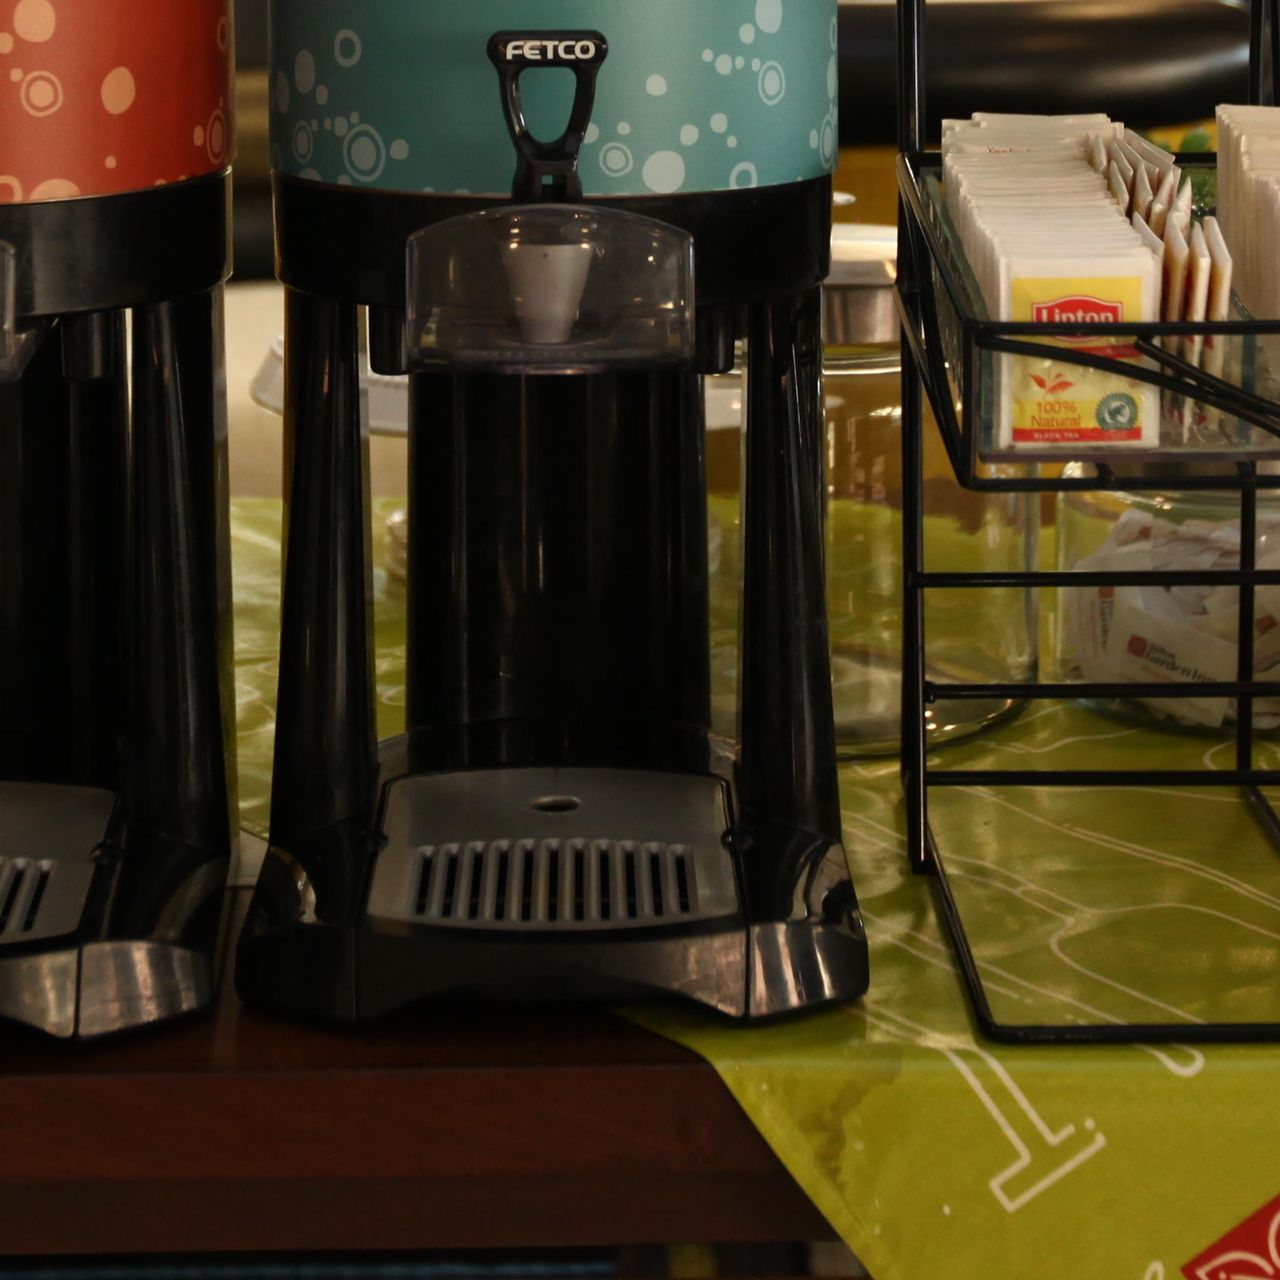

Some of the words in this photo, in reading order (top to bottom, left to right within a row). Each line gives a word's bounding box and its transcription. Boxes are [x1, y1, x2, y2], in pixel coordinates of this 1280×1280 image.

[505, 39, 596, 60] FETCO
[1036, 400, 1078, 415] 100%
[1031, 415, 1082, 427] Natural
